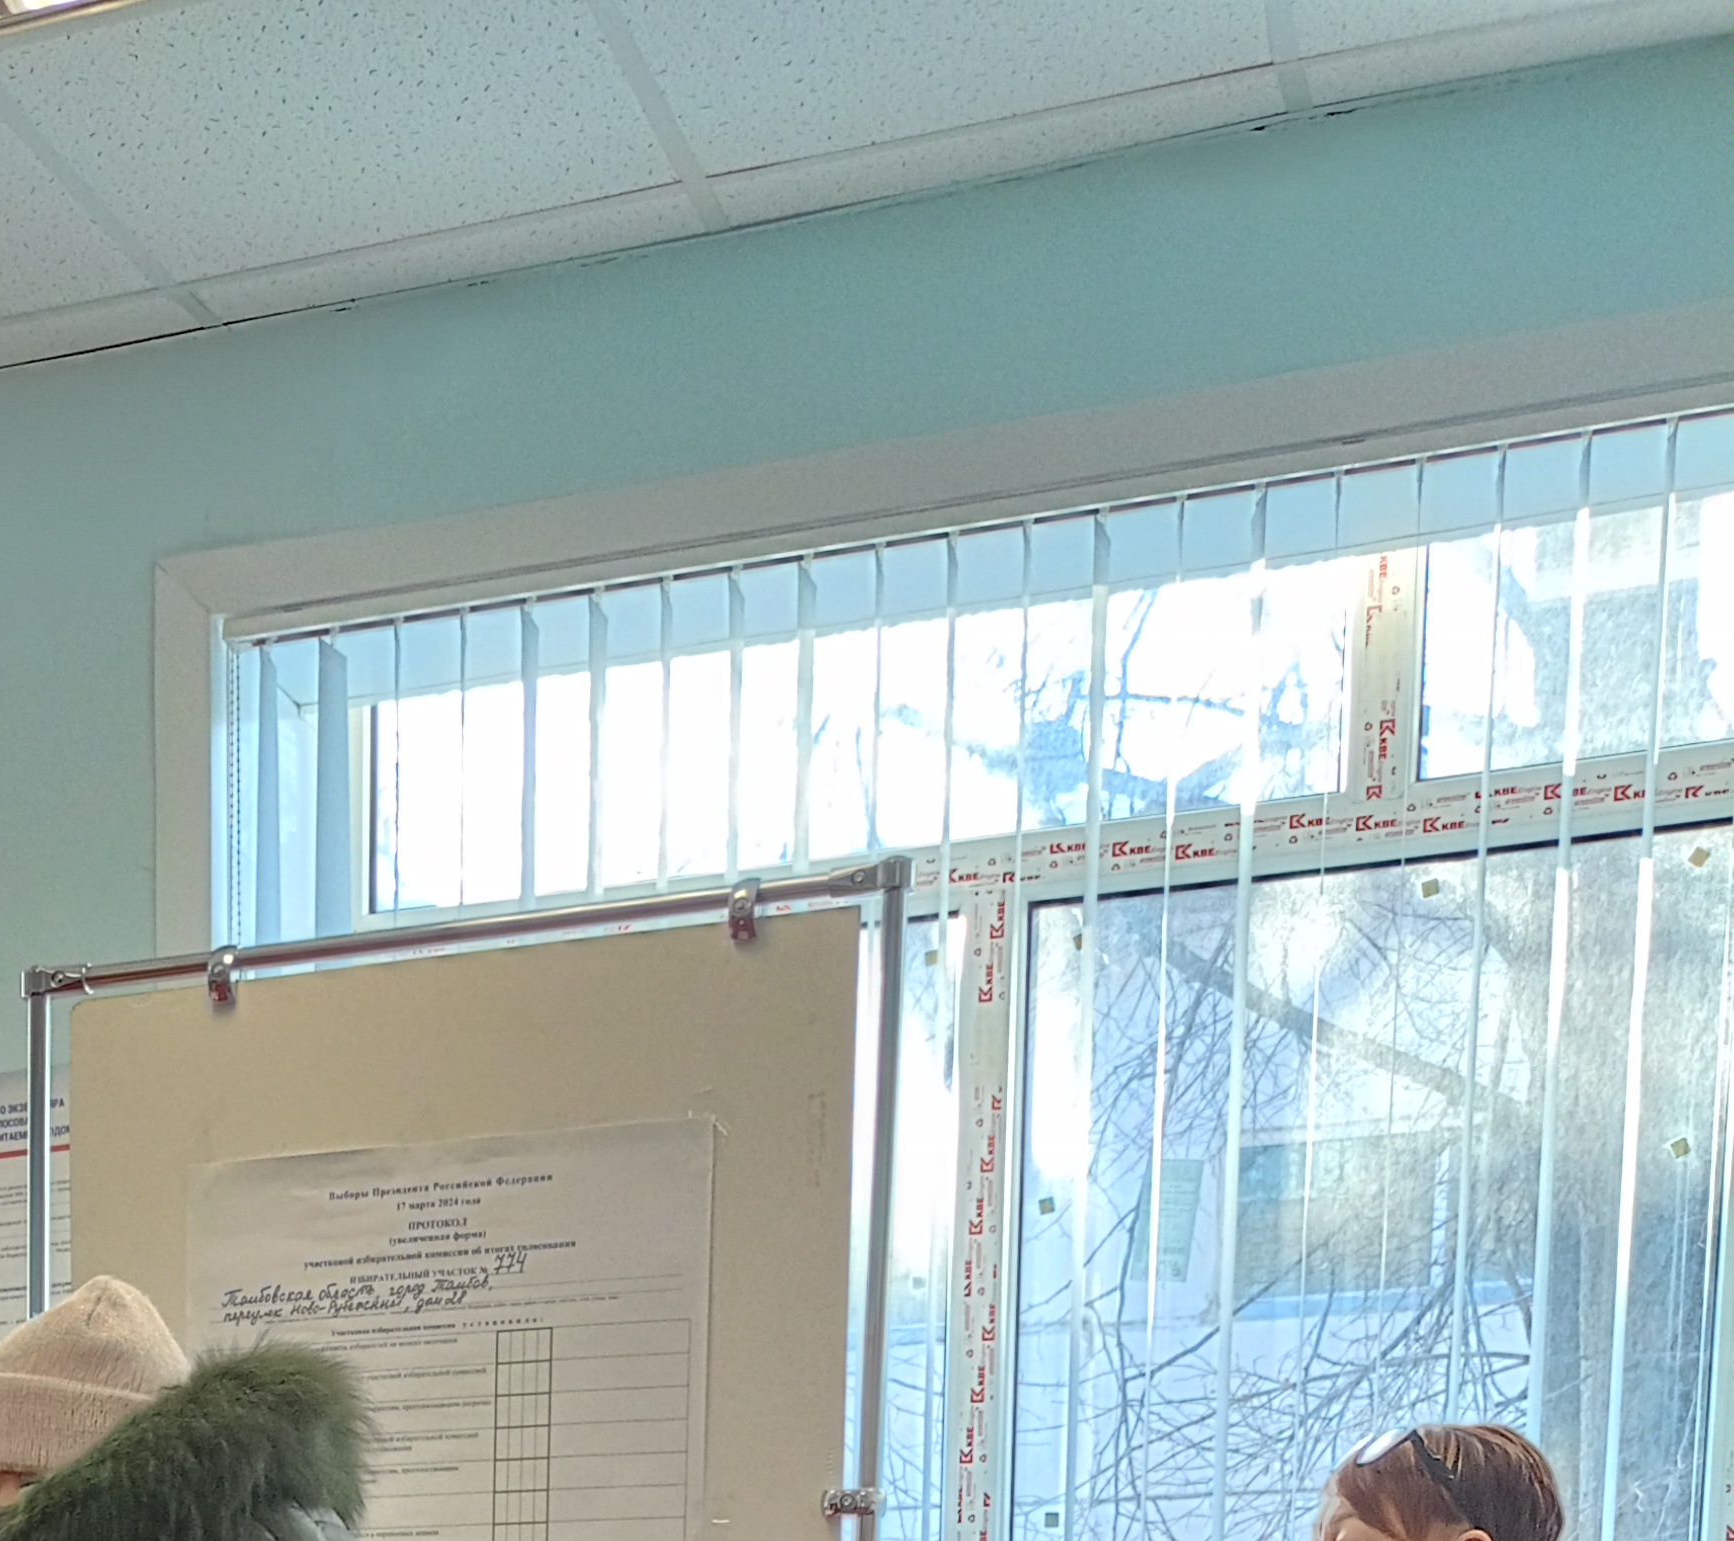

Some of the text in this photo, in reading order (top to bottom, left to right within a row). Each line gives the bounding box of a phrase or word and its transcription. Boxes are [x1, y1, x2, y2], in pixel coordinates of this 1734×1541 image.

[329, 1174, 553, 1202] Выборы Президента Российской Федерации
[396, 1196, 481, 1213] 17 марта 2024 года
[408, 1218, 468, 1231] ПРОТОКОЛ
[389, 1229, 486, 1246] (увеличенная форма)
[304, 1239, 577, 1271] участковой избирательной комиссии об итогах голосования
[494, 1252, 527, 1275] 774
[350, 1269, 429, 1284] ИЗБИРАТЕЛЬНЫЙ
[432, 1267, 477, 1279] УЧАСТОК
[221, 1284, 313, 1308] Тамбовская
[389, 1283, 426, 1300] город
